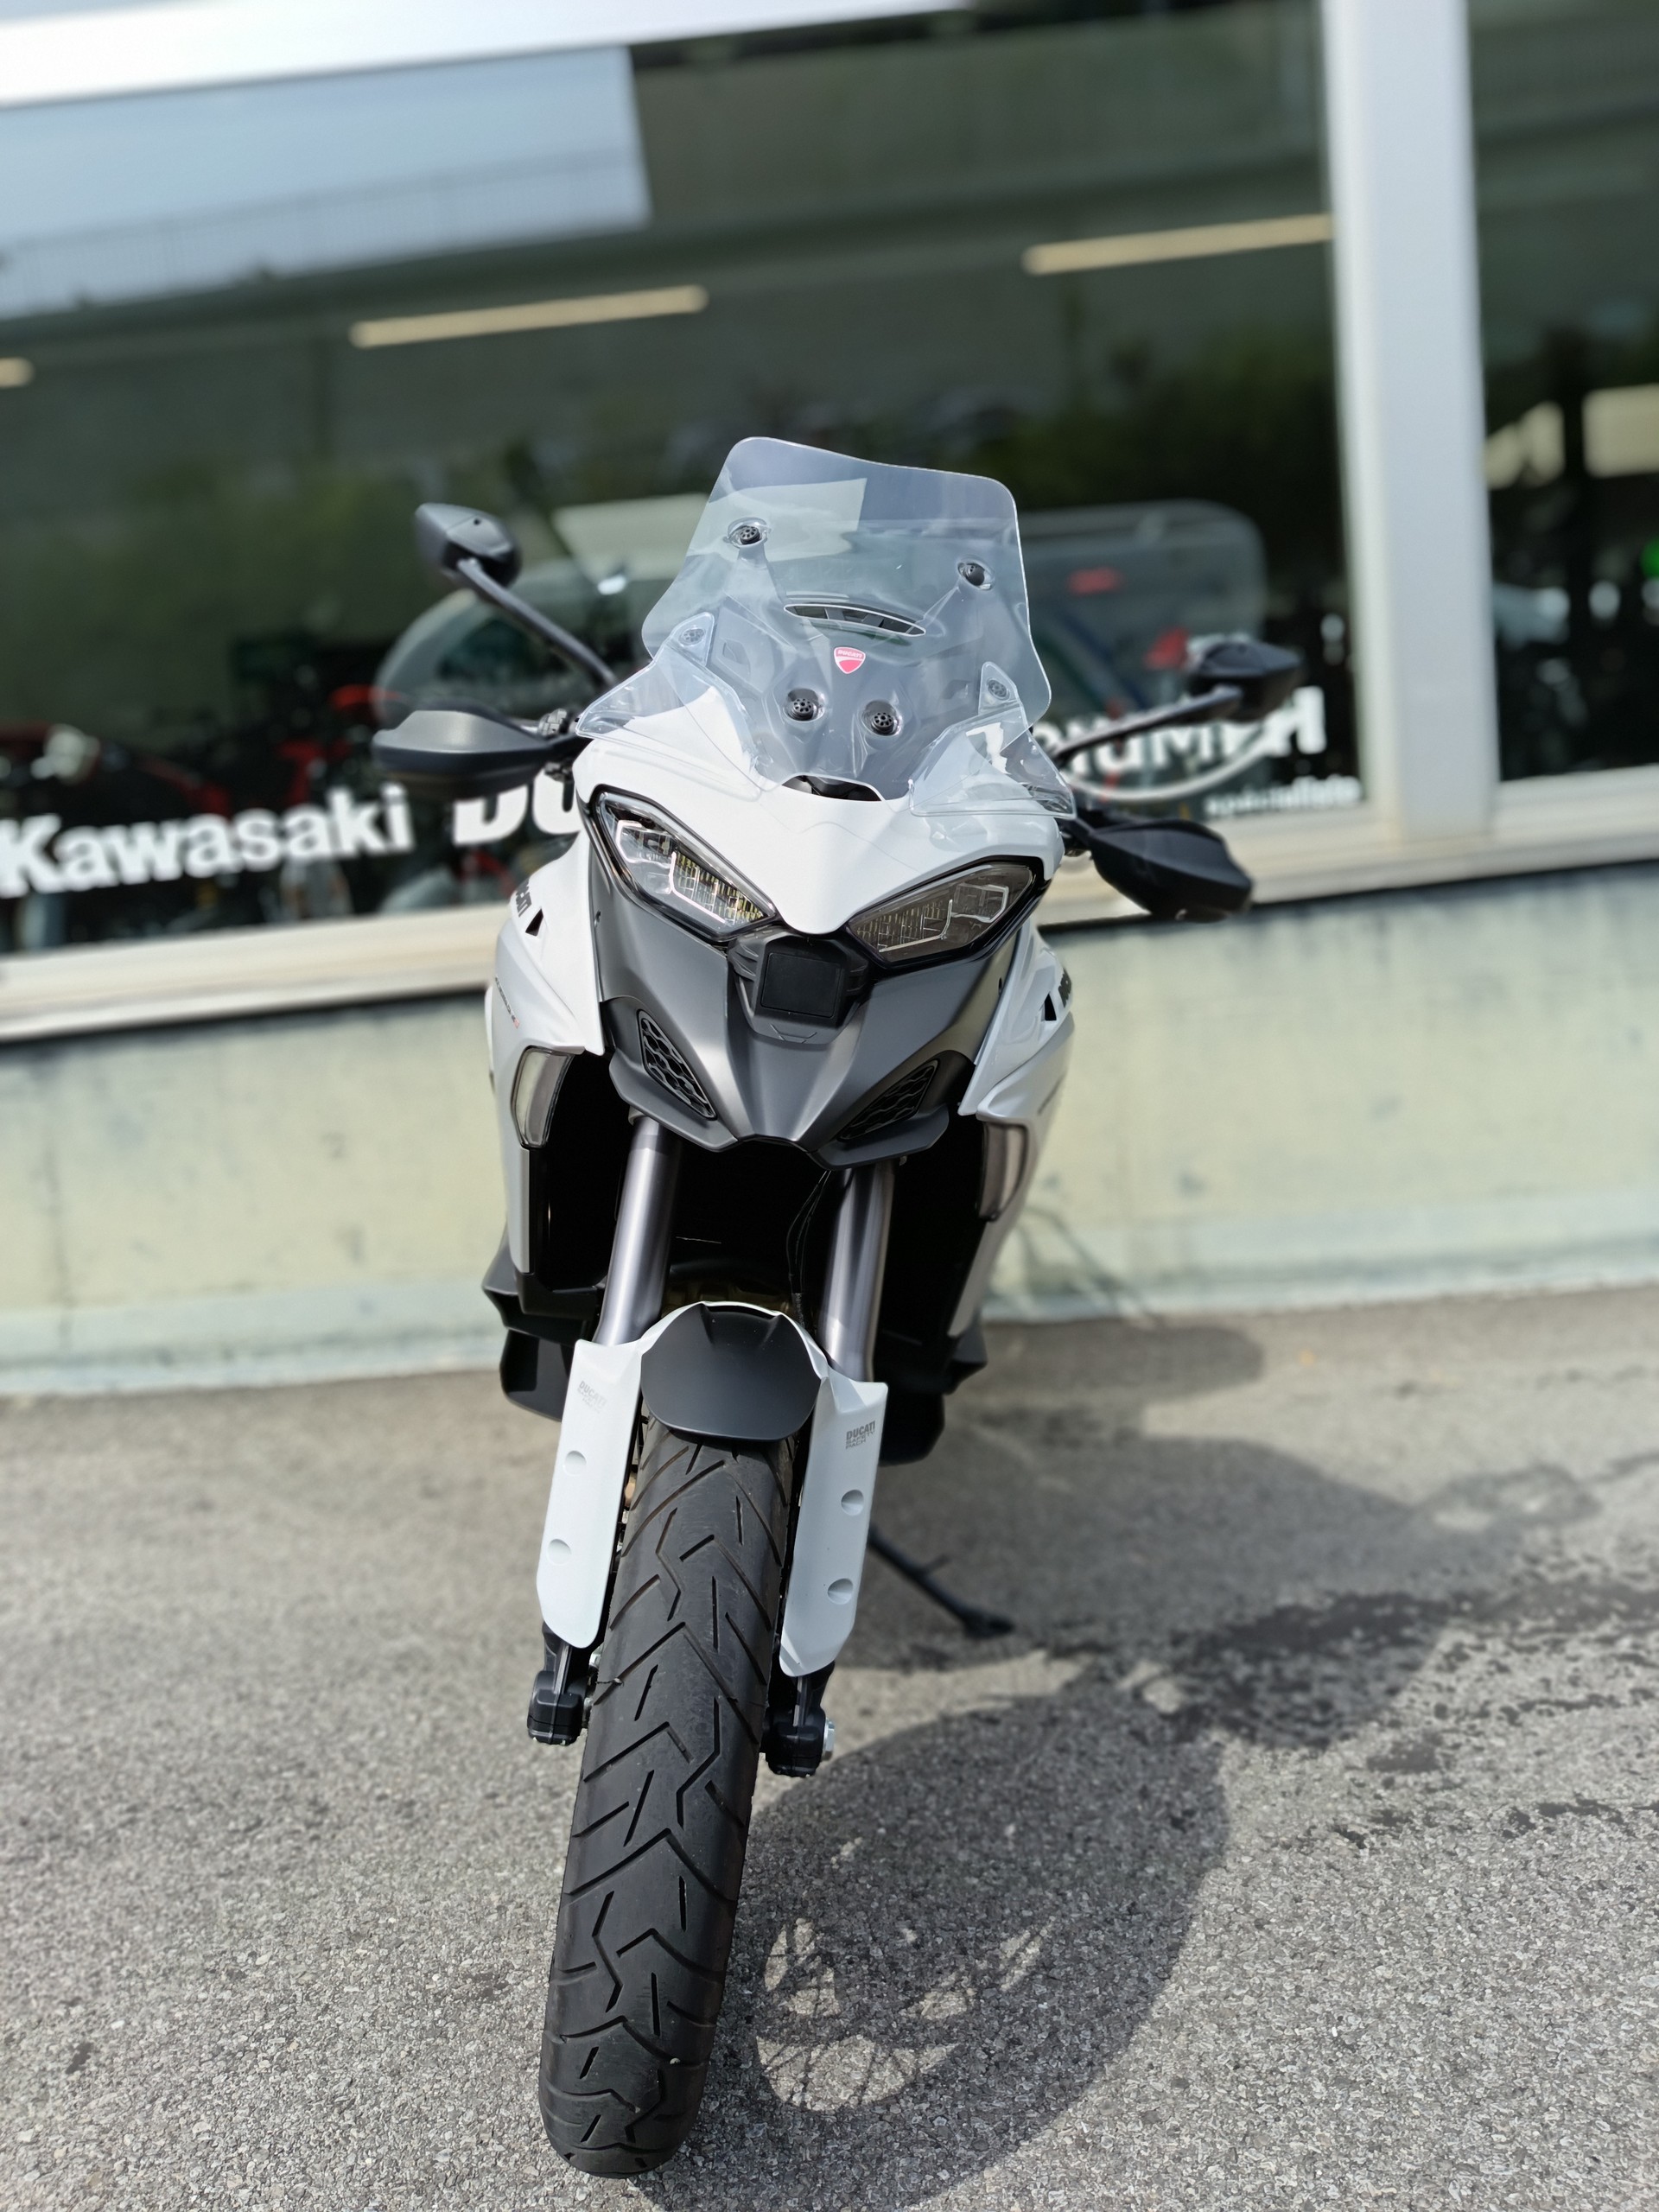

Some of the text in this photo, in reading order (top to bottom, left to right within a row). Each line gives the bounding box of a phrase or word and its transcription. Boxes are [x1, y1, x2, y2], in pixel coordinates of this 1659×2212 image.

[838, 649, 862, 658] DUCATI
[0, 783, 413, 899] Kawasaki
[847, 1420, 875, 1440] DUCATI
